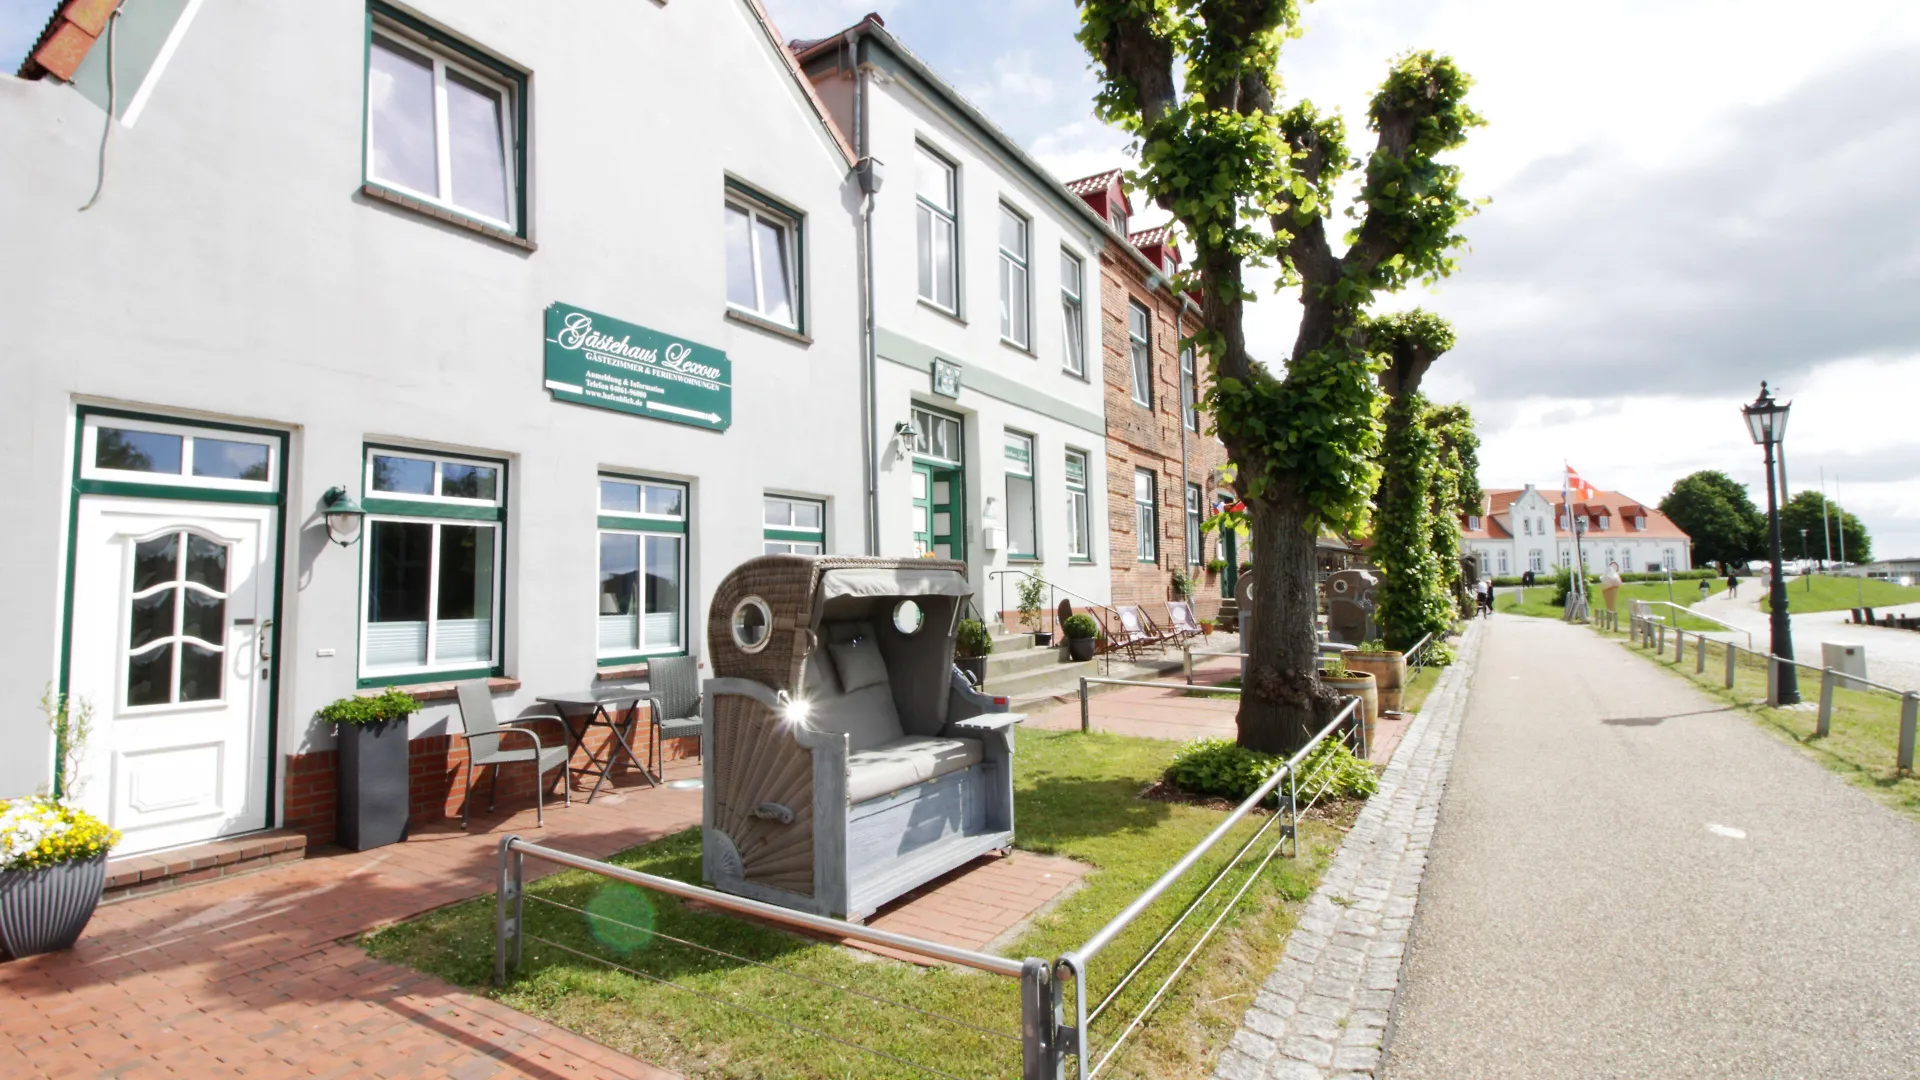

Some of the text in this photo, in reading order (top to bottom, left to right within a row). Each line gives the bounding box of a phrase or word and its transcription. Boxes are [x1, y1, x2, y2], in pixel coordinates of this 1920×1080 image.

[558, 312, 721, 380] Gästehaus Lexow
[585, 352, 720, 392] GÄSTEZIMMER & FERIENWOHNUNGEN
[585, 370, 665, 394] Anmeldung & Information
[585, 379, 609, 390] Telefon
[585, 389, 643, 406] www.hafenblick.de
